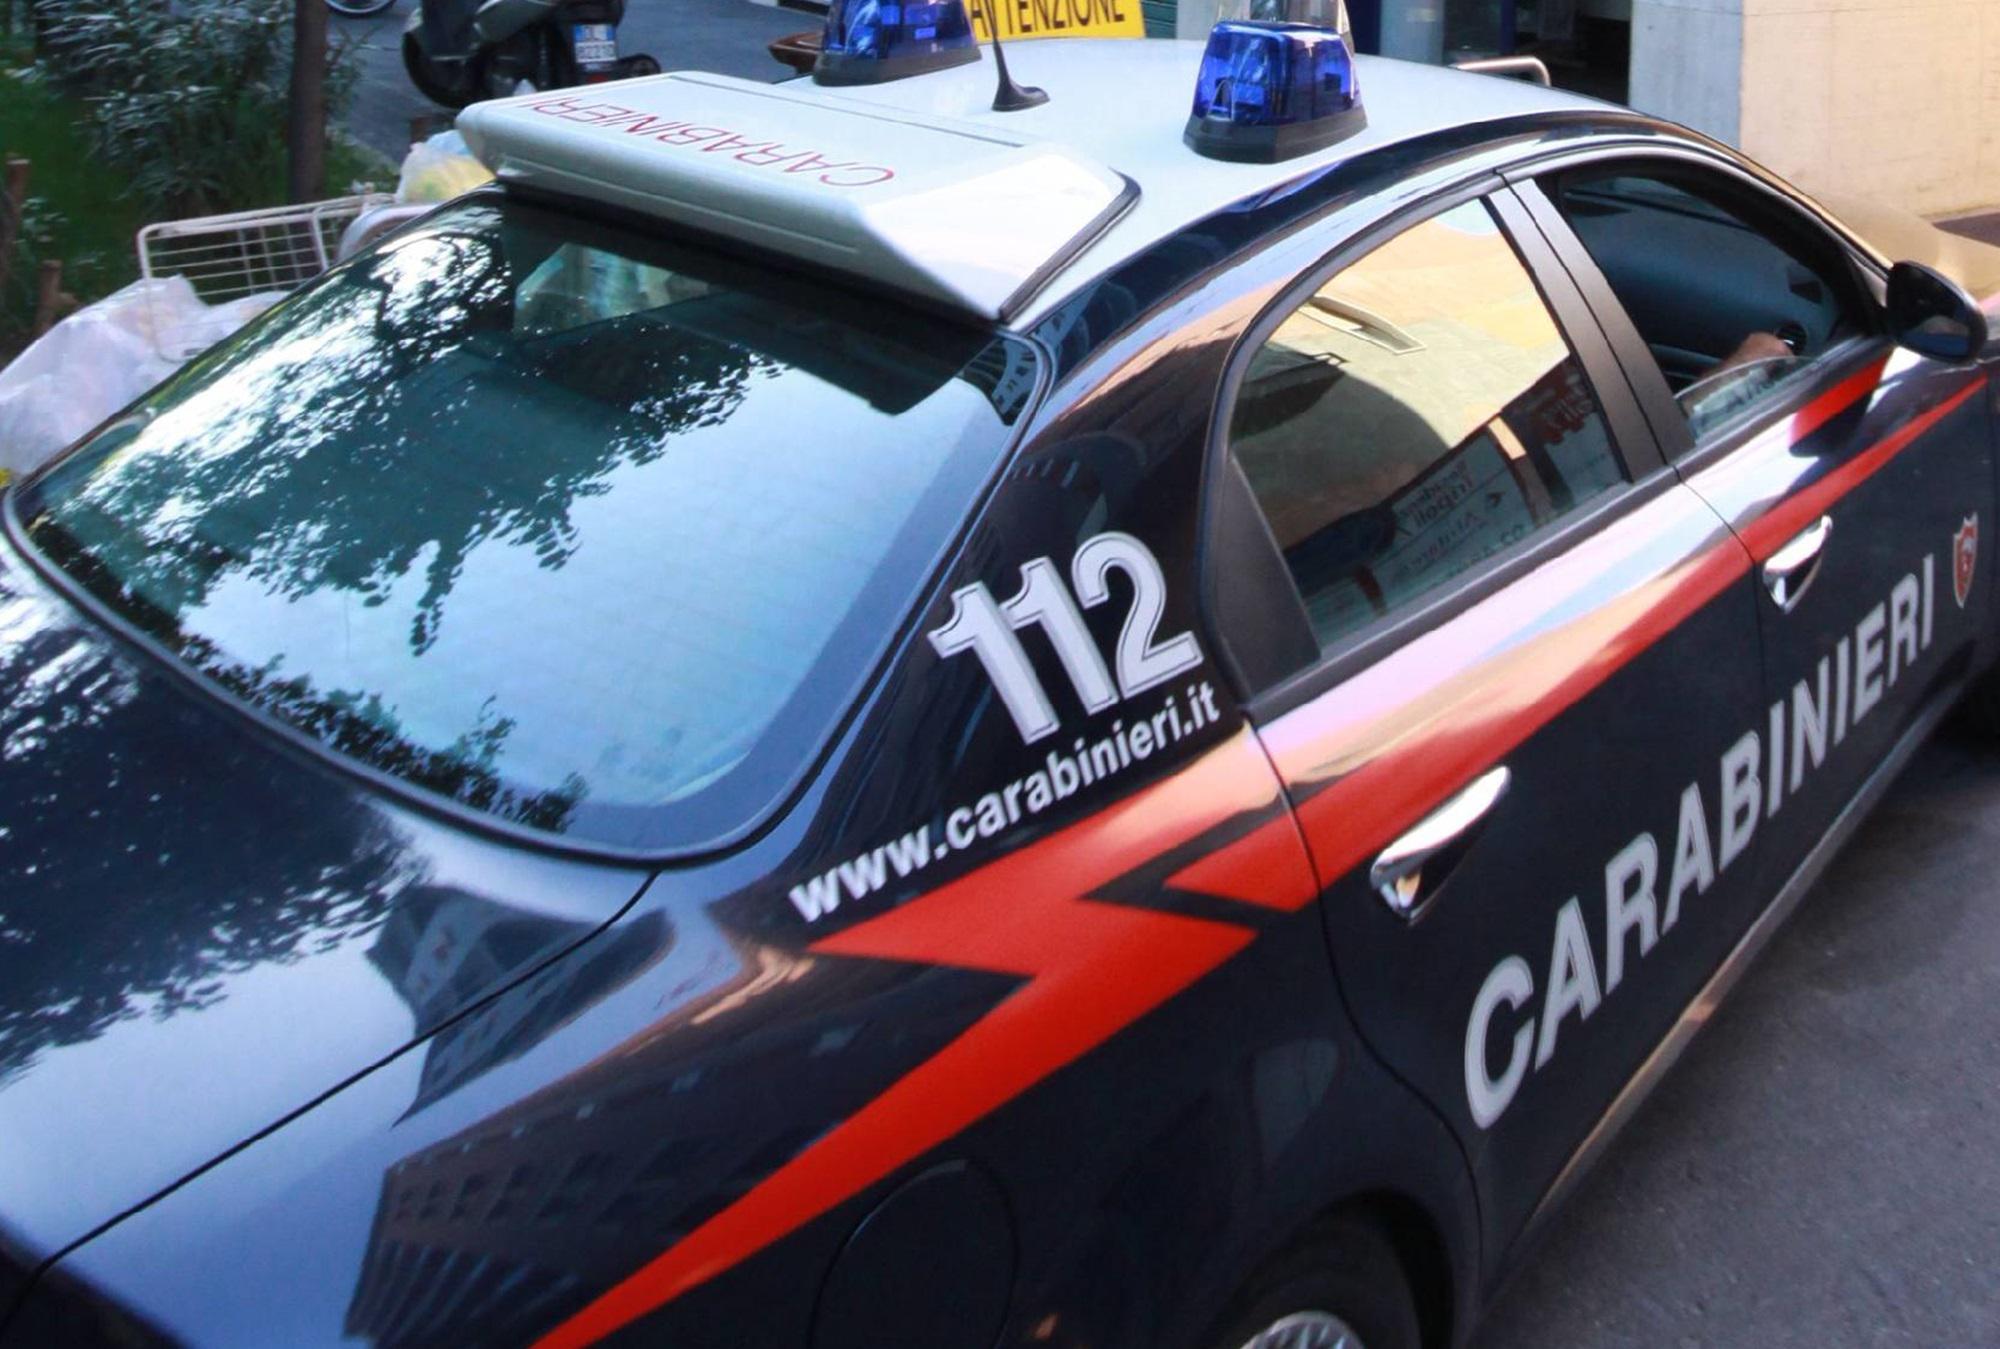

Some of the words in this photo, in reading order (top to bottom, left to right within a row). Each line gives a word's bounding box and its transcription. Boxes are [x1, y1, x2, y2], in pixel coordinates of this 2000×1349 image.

[516, 97, 895, 187] CARABINIERI
[927, 531, 1203, 746] 112
[789, 680, 1220, 923] www.carabinieri.it
[1464, 553, 1934, 1130] CARABINIERI
